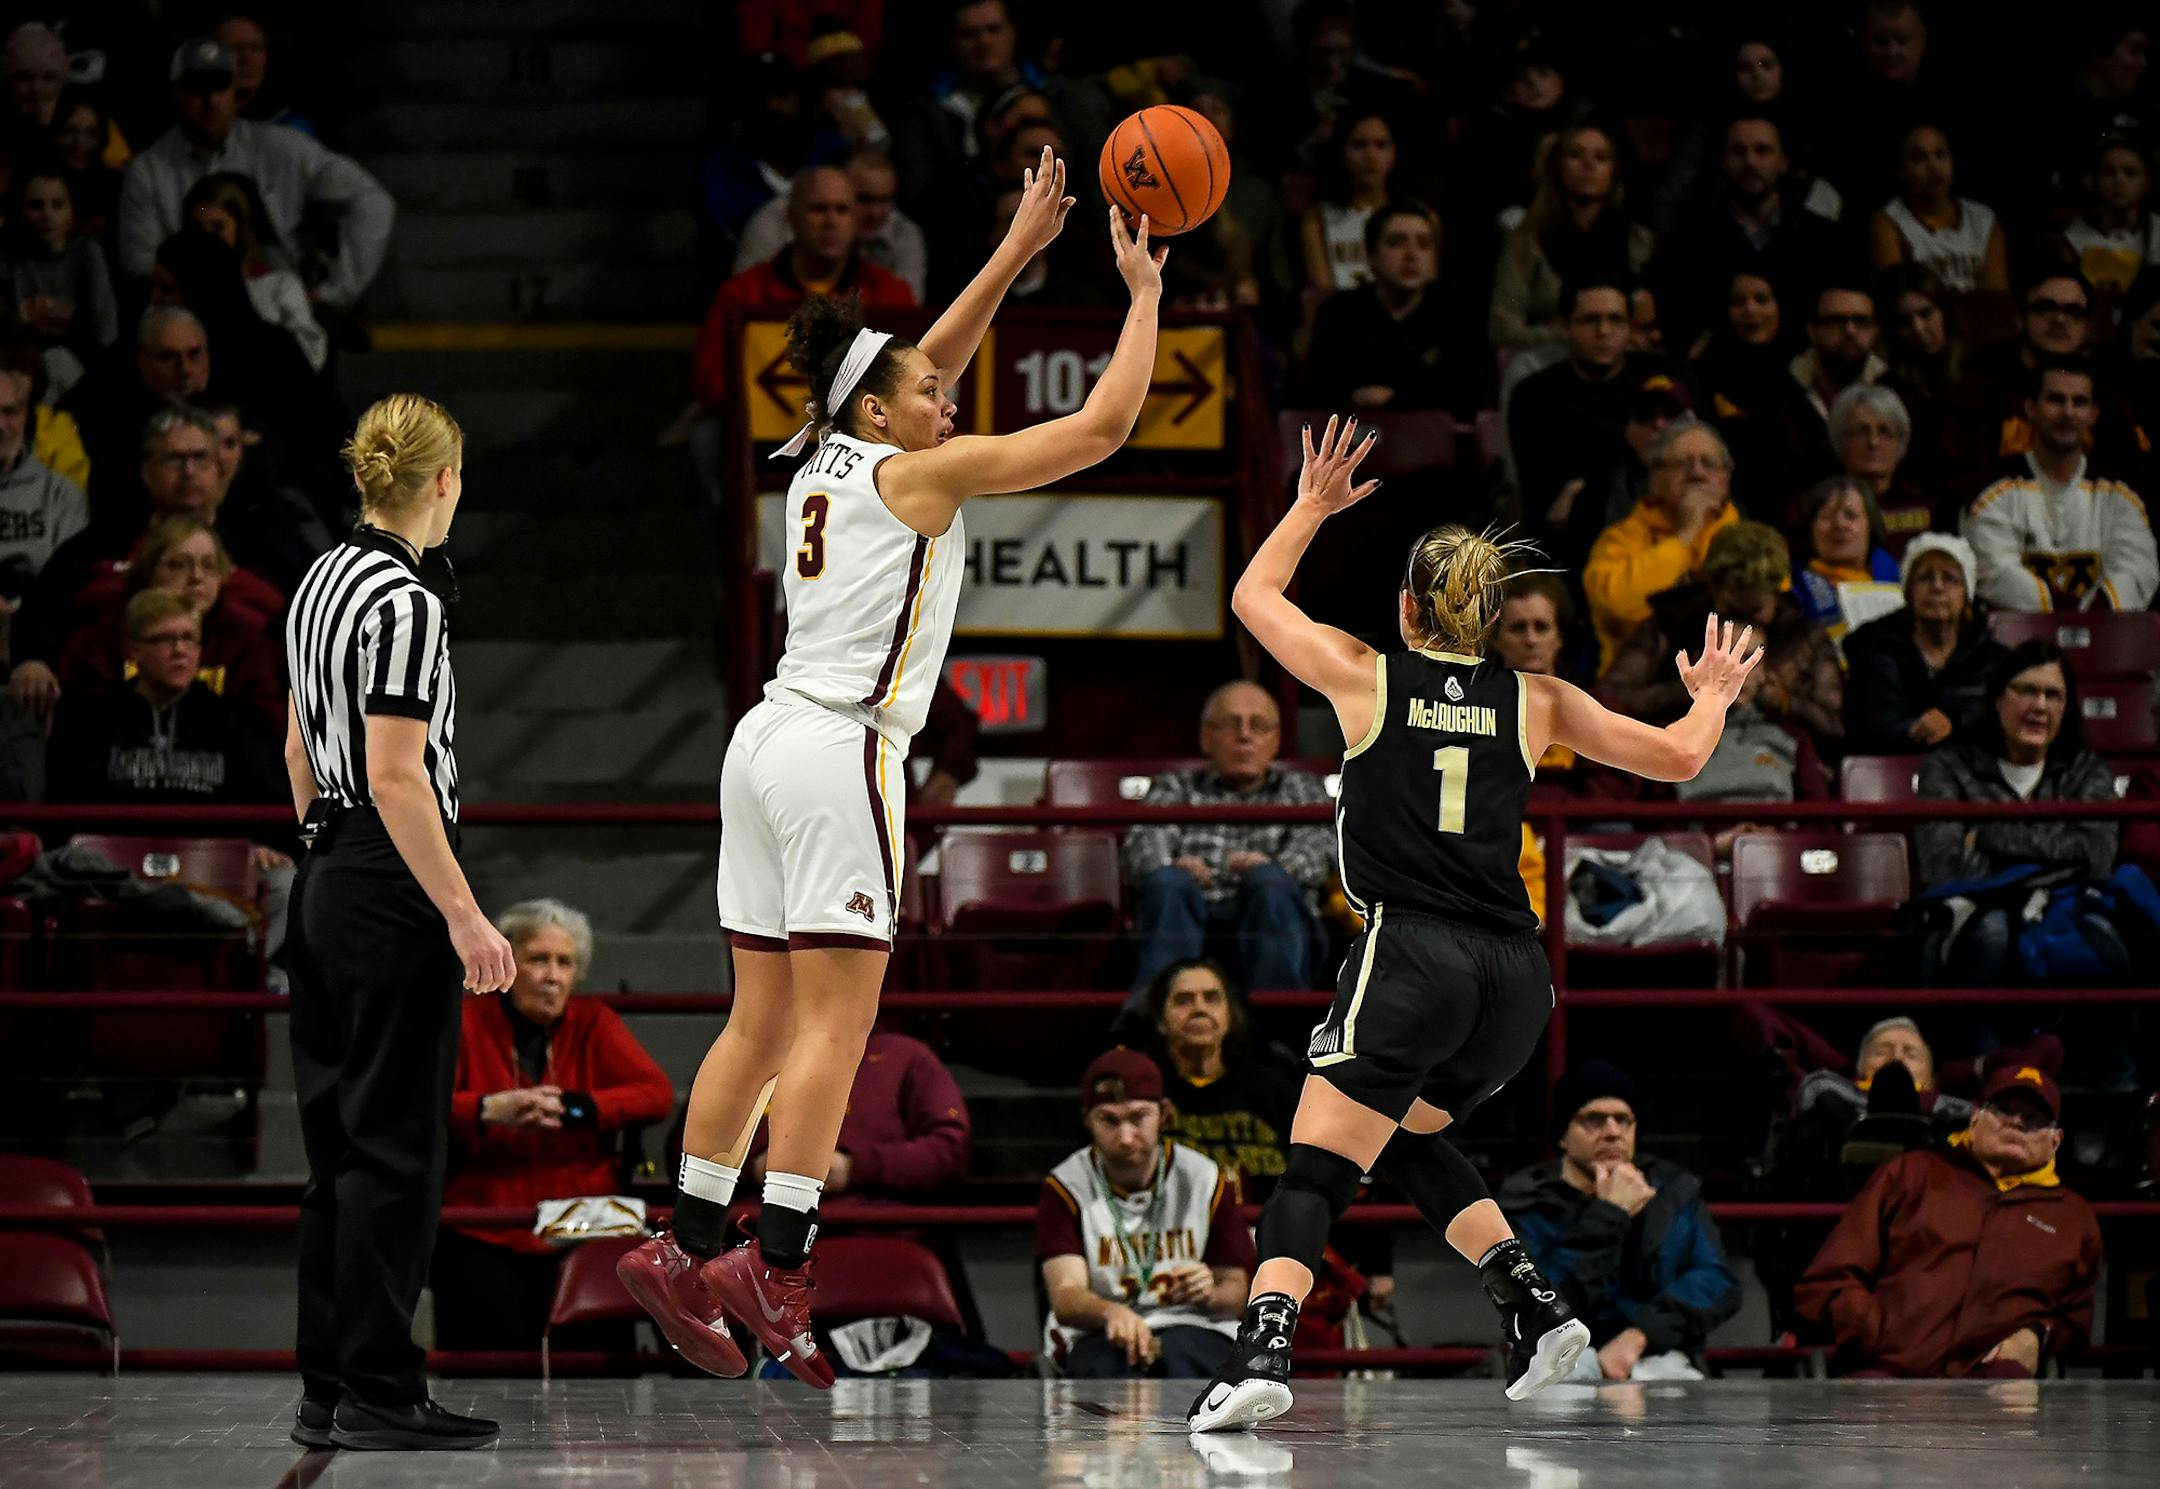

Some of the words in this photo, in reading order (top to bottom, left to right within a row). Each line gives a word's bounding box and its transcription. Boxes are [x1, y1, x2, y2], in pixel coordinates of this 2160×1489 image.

[797, 491, 831, 580] 3
[965, 539, 1190, 588] HEALTH
[1433, 745, 1470, 834] 1
